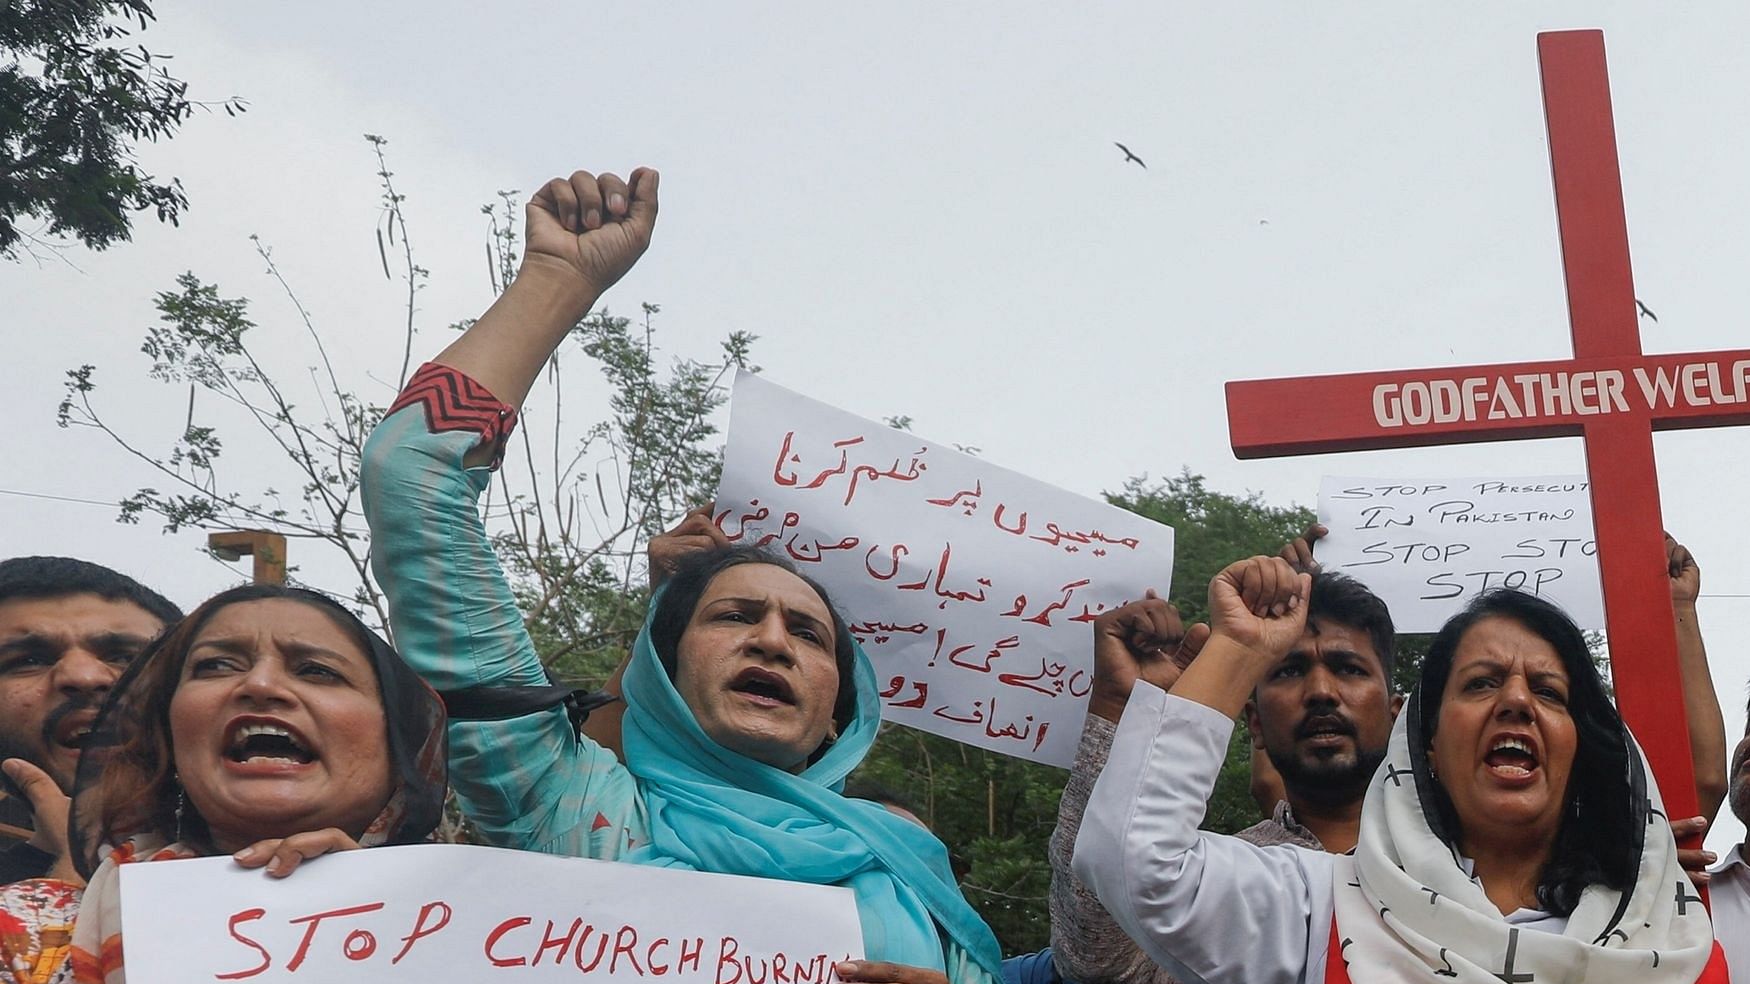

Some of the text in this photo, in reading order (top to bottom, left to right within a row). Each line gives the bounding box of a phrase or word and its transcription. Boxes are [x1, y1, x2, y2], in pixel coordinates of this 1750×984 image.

[1373, 369, 1630, 428] GODFATHER
[773, 431, 866, 493] کرنا
[926, 478, 983, 516] پر
[1330, 478, 1589, 499] STOP PERSECUT
[1354, 500, 1575, 531] IN PAKISTAN
[1341, 536, 1597, 568] STOP STO
[1419, 566, 1564, 602] STOP
[997, 657, 1066, 698] چلے
[215, 900, 453, 982] STOP
[483, 915, 703, 977] CHURCH
